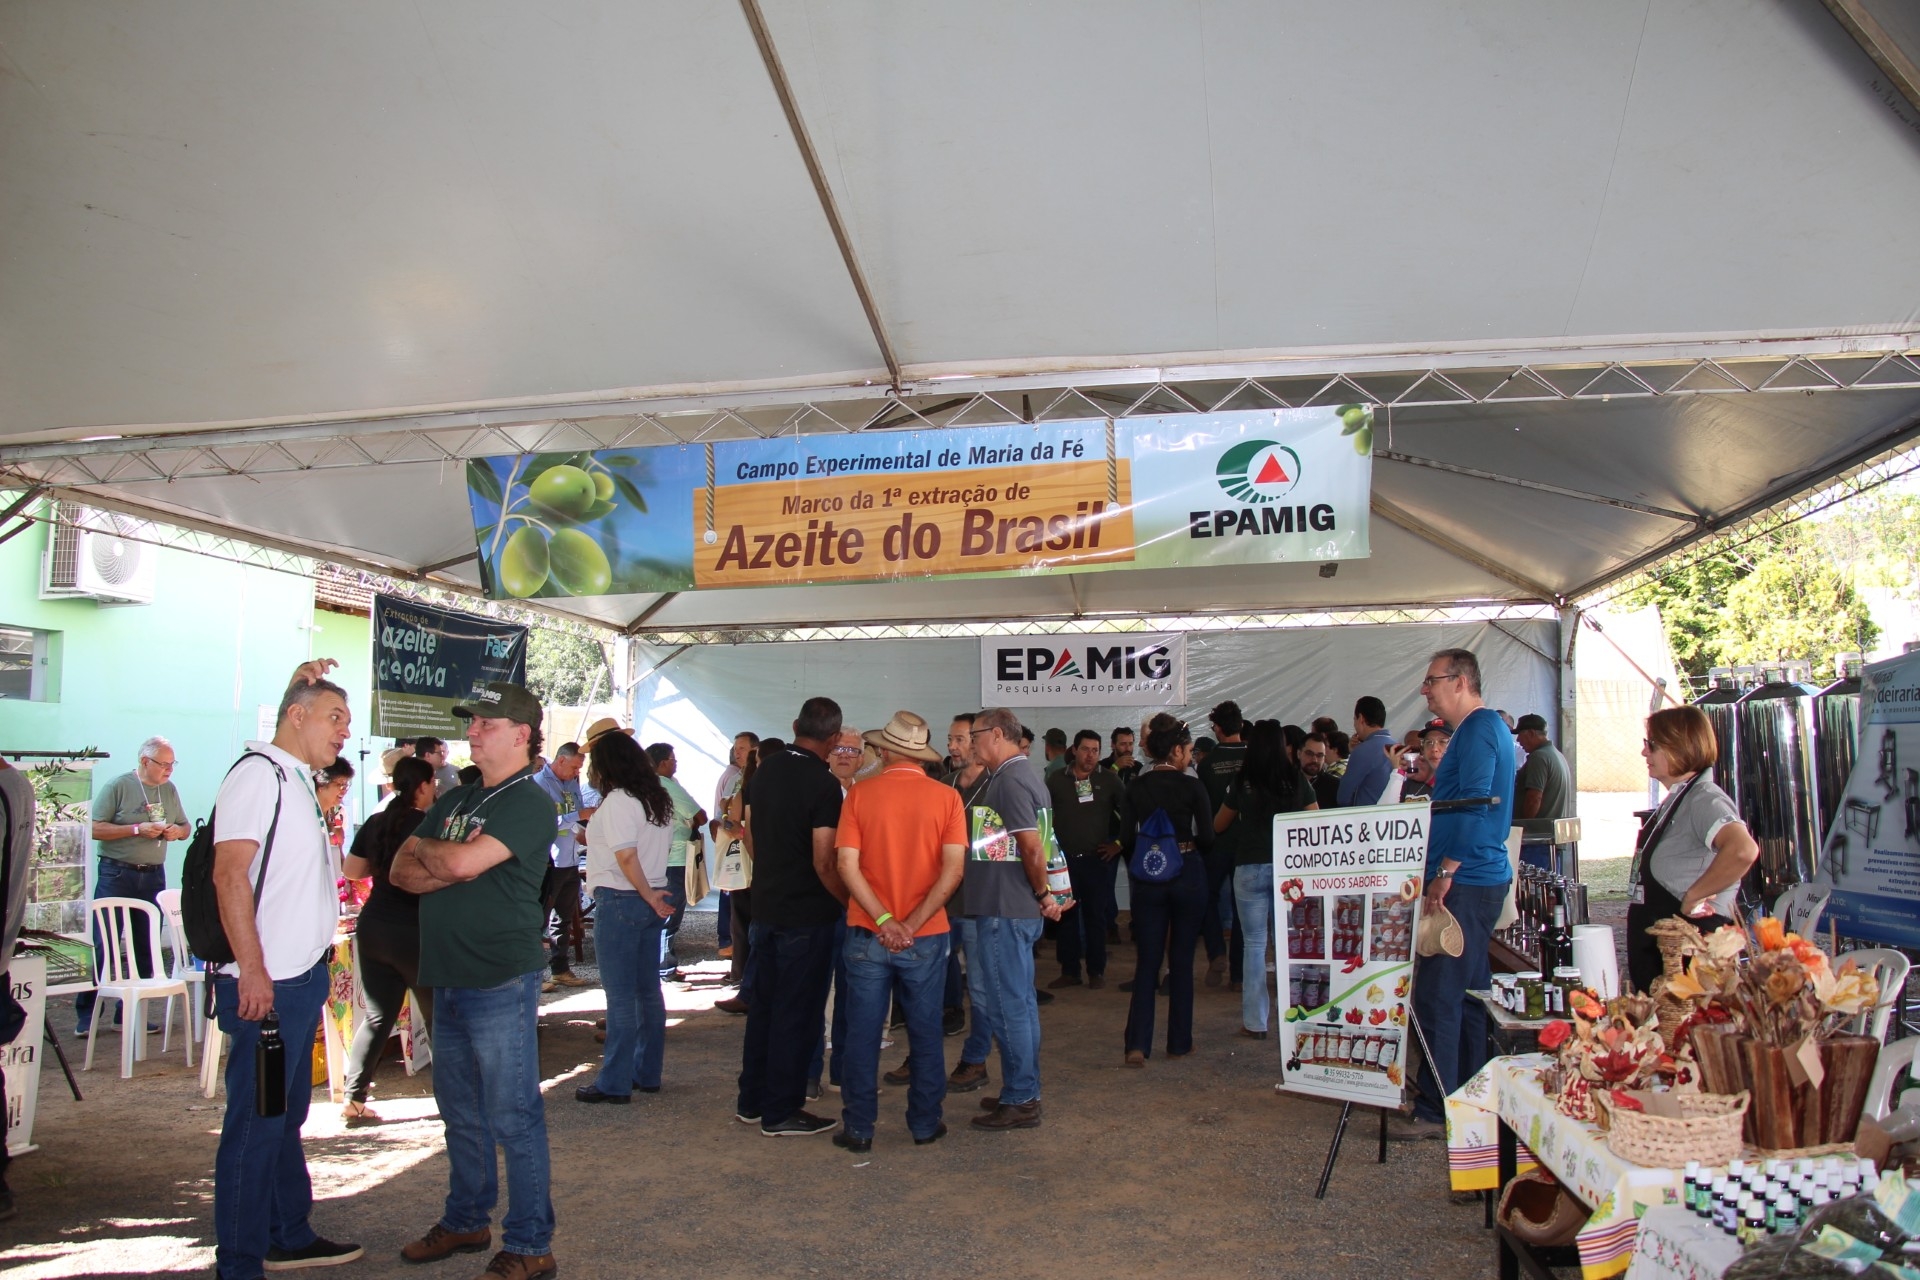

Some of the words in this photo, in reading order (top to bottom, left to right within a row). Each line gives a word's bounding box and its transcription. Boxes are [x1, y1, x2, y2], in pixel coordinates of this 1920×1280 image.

[736, 461, 799, 480] Campo
[806, 449, 931, 476] Experimental
[937, 449, 961, 467] de
[968, 444, 1023, 465] Maria
[1030, 442, 1054, 460] da
[1061, 438, 1084, 459] Fé
[782, 495, 843, 515] Marco
[850, 490, 874, 510] da
[882, 487, 902, 508] 1ª
[908, 484, 998, 507] extração
[1005, 482, 1031, 500] de
[714, 519, 865, 571] Azeite
[882, 512, 941, 562] do
[960, 501, 1104, 557] Brasil
[1190, 504, 1336, 539] EPAMIG
[420, 614, 429, 625] de
[381, 622, 437, 654] azeite
[485, 633, 510, 659] Fast
[404, 656, 447, 688] oliva
[997, 646, 1171, 681] EPAMIG
[997, 683, 1061, 695] Pesquisa
[1873, 683, 1920, 704] deiraria
[1287, 824, 1353, 847] FRUTAS
[1358, 822, 1370, 843] &
[1375, 818, 1423, 841] VIDA
[1284, 851, 1355, 869] COMPOTAS
[1358, 854, 1365, 865] e
[1367, 847, 1423, 864] GELEIAS
[1312, 877, 1346, 890] NOVOS
[1349, 875, 1388, 888] SABORES
